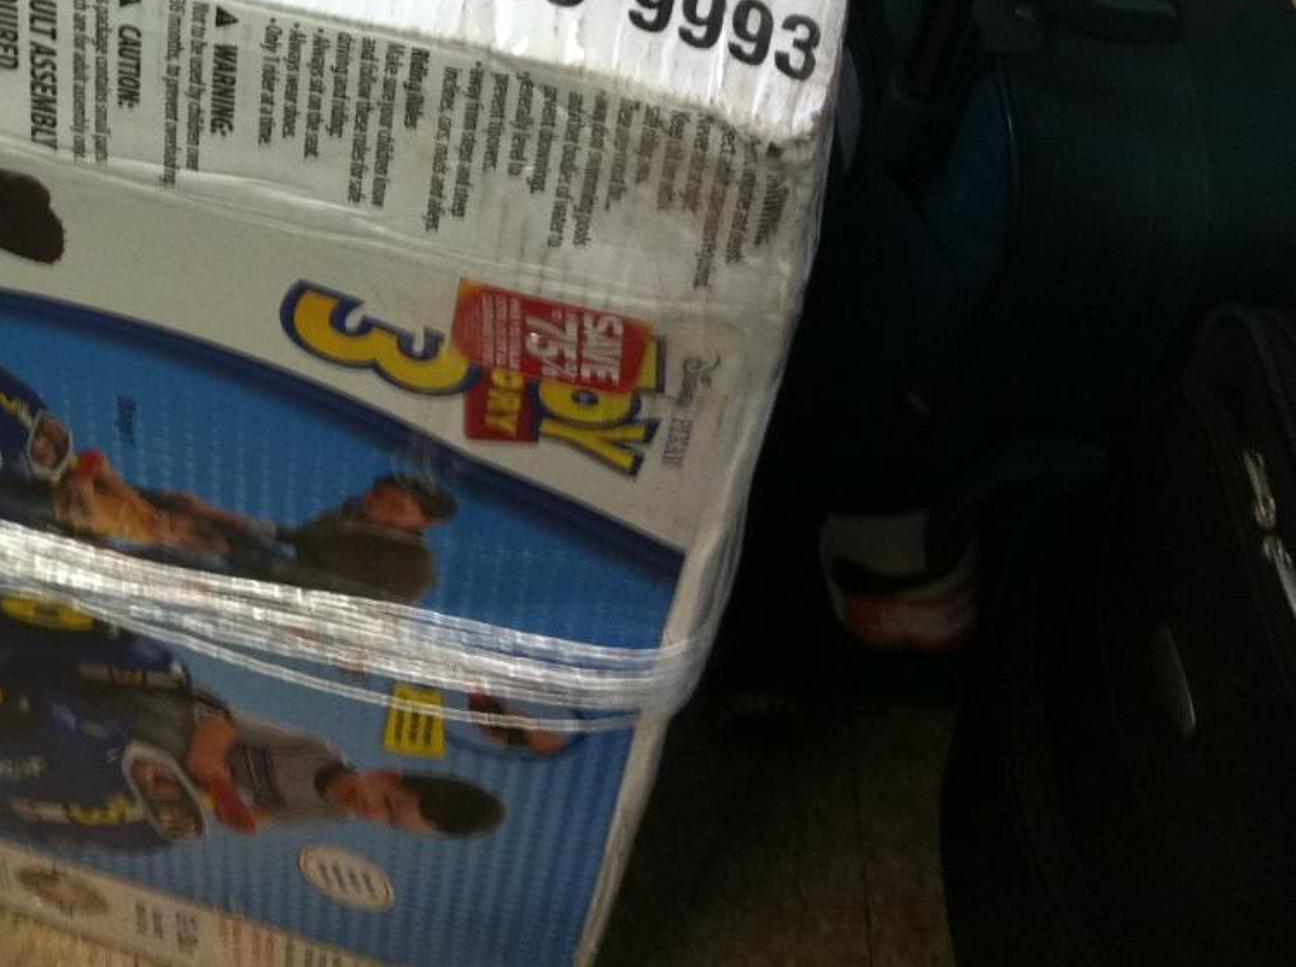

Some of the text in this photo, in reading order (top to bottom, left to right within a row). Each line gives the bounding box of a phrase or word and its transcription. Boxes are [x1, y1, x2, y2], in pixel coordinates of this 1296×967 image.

[30, 41, 57, 150] ASSEMBLY
[118, 25, 141, 108] CAUTION:
[210, 44, 237, 136] WARNING:
[279, 277, 482, 398] 3
[580, 314, 625, 386] SAVE
[526, 336, 667, 480] OY
